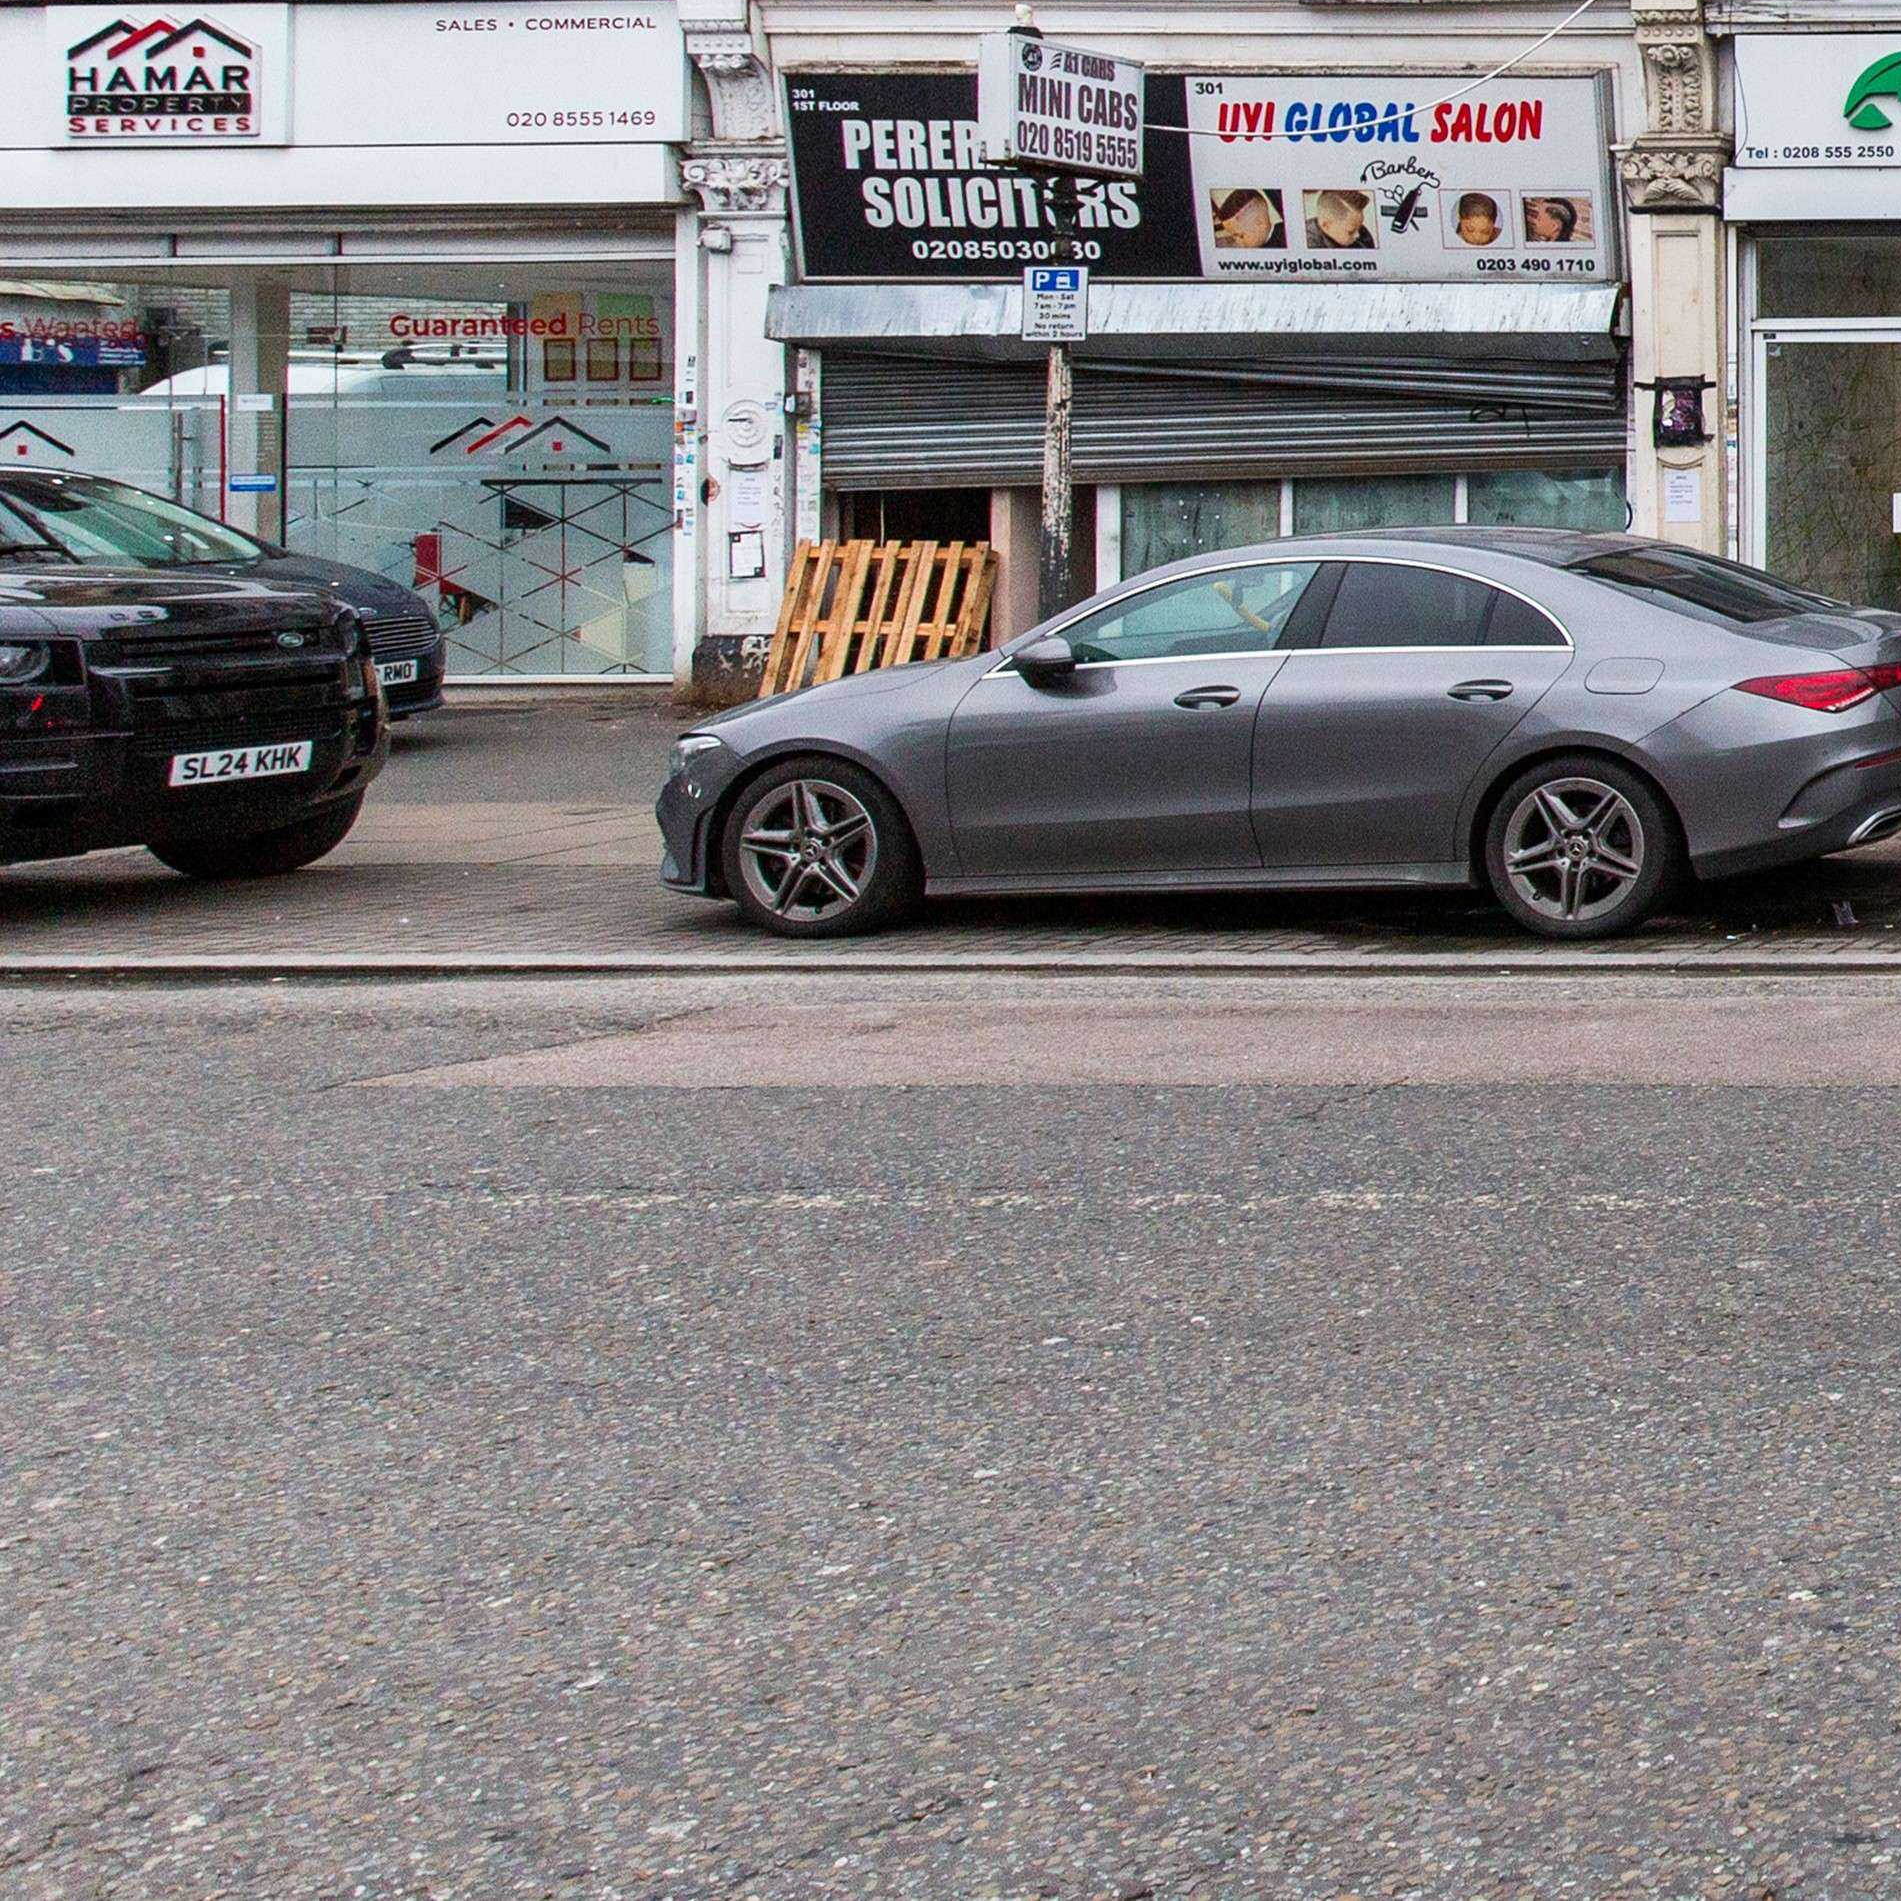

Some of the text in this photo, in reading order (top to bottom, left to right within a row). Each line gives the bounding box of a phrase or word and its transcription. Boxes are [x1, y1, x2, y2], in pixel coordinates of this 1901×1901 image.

[436, 17, 657, 32] SALES COMMERCIAL
[67, 65, 251, 92] HAMAR
[793, 89, 815, 99] 301
[1195, 81, 1224, 95] 301
[70, 96, 244, 113] PROPERTY
[793, 101, 860, 112] 1ST FLOOR
[1018, 72, 1138, 132] MINI CABS
[68, 116, 251, 133] SERVICES
[506, 110, 656, 127] 020 8555 1469
[1217, 99, 1543, 144] UYI GLOBAL SALON
[841, 119, 1018, 171] PERER
[1017, 120, 1138, 169] 020 8519 5555
[1782, 146, 1820, 159] 0208
[1824, 146, 1852, 158] 555
[1856, 145, 1894, 158] 2550
[1366, 155, 1440, 182] Barber
[862, 176, 1142, 229] SOLICITRS
[912, 240, 1102, 260] 0208503030
[1217, 257, 1378, 274] www.uyiglobal.com
[1476, 258, 1596, 272] 0203 490 1710
[1036, 271, 1050, 288] P
[389, 312, 660, 337] Guaranteed Rents
[183, 746, 302, 781] SL24 KHK
